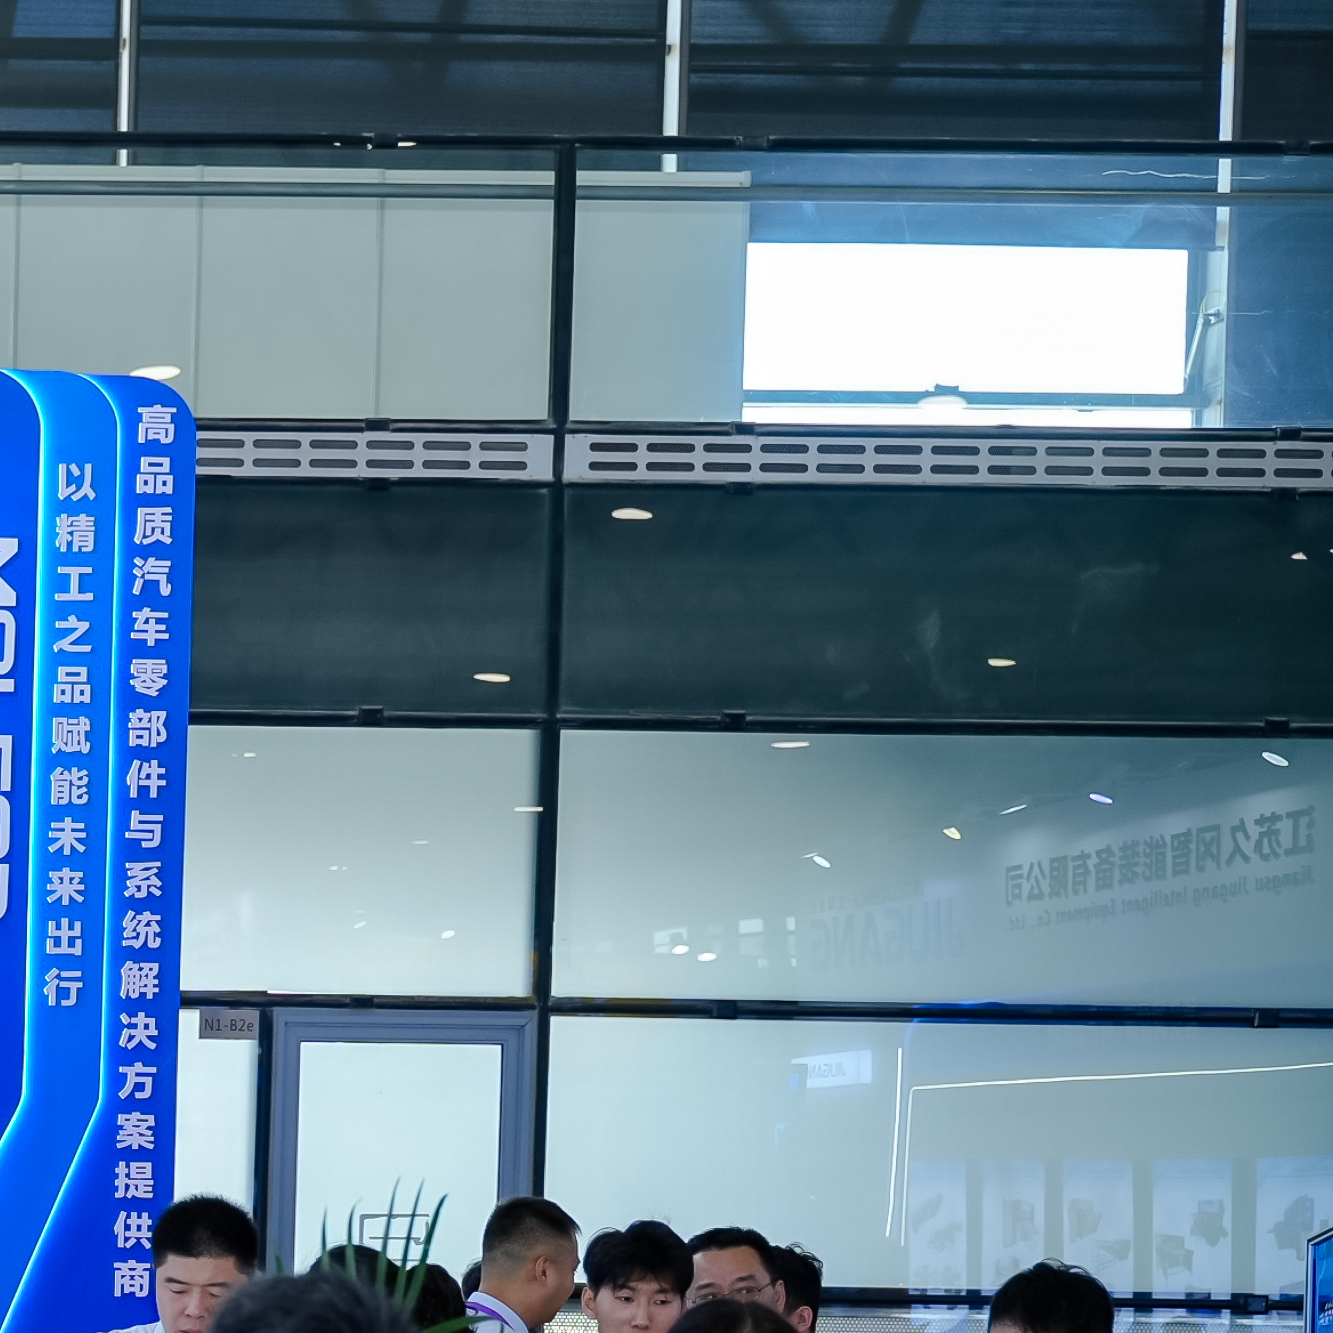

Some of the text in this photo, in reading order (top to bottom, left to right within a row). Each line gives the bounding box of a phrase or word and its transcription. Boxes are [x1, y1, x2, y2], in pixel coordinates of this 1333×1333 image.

[42, 461, 97, 1008] 以精工之品赋能未来出行
[112, 403, 178, 1299] 高品质汽车零部件与系统解决方案提供商
[204, 1018, 255, 1033] N1-B2e
